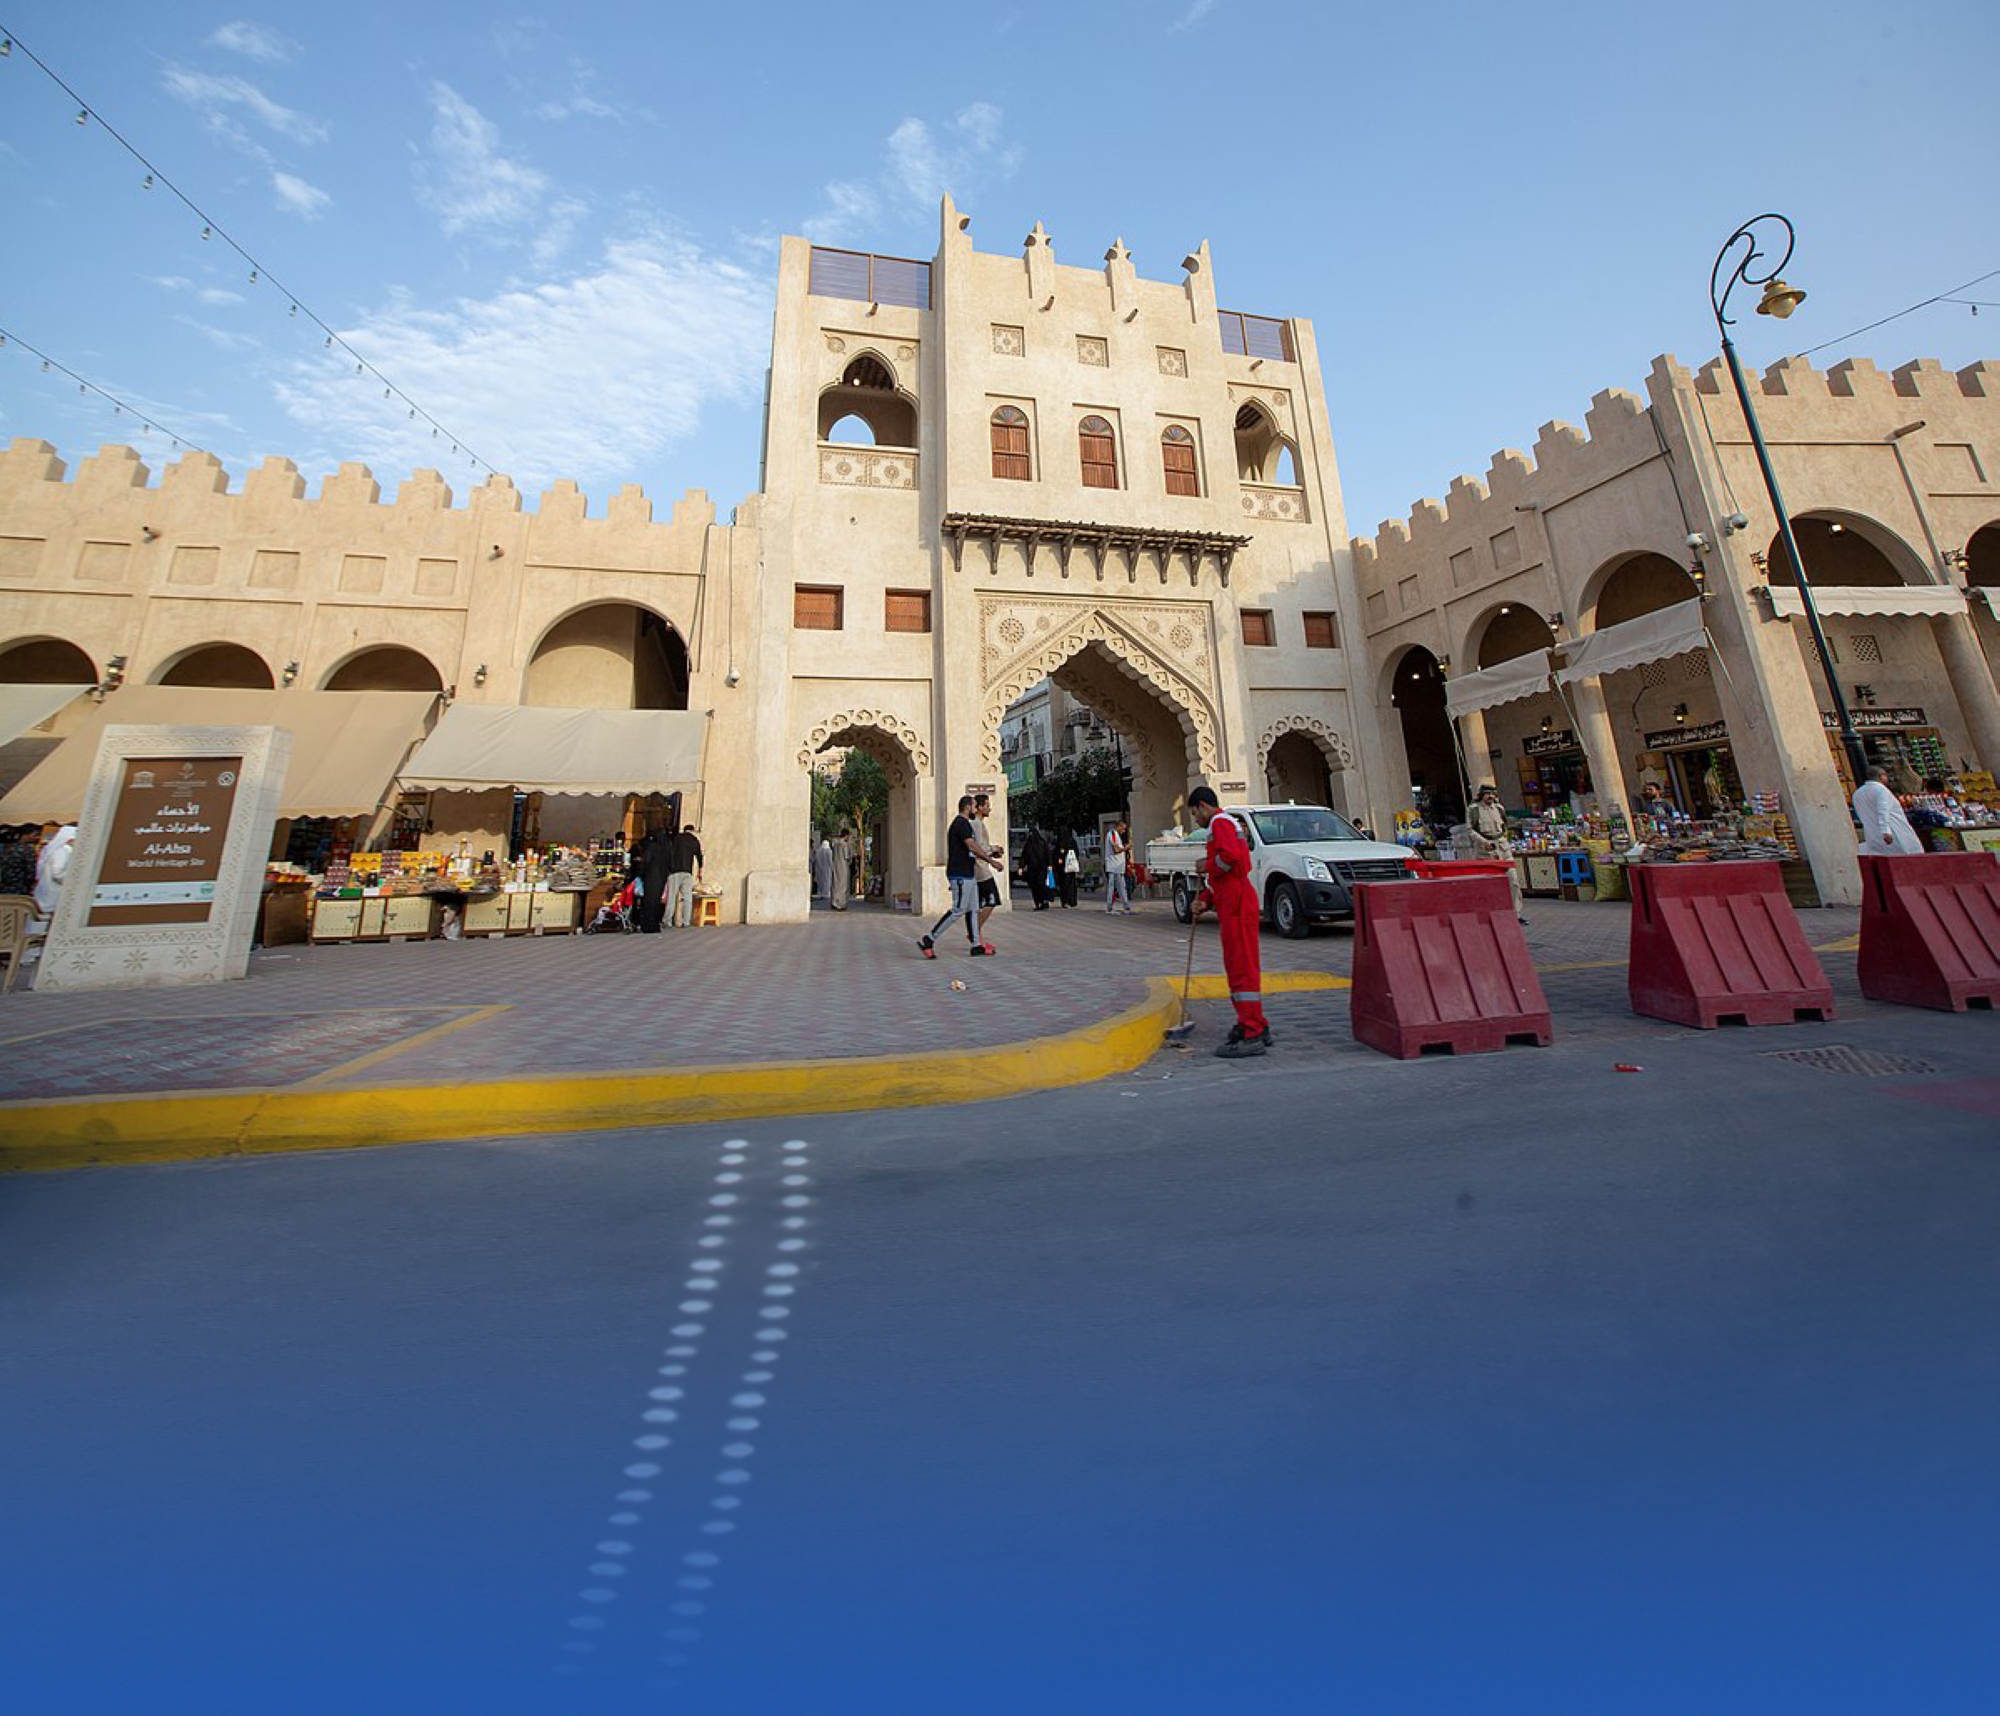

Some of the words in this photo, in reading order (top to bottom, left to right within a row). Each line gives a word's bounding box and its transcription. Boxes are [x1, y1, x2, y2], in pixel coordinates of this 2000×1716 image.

[157, 802, 199, 815] الأحساء
[134, 822, 164, 835] عالمي
[166, 822, 185, 833] تراث
[186, 823, 211, 833] موقع
[144, 843, 191, 854] Al-Ahsa
[128, 859, 153, 868] World
[155, 859, 188, 868] Heritage
